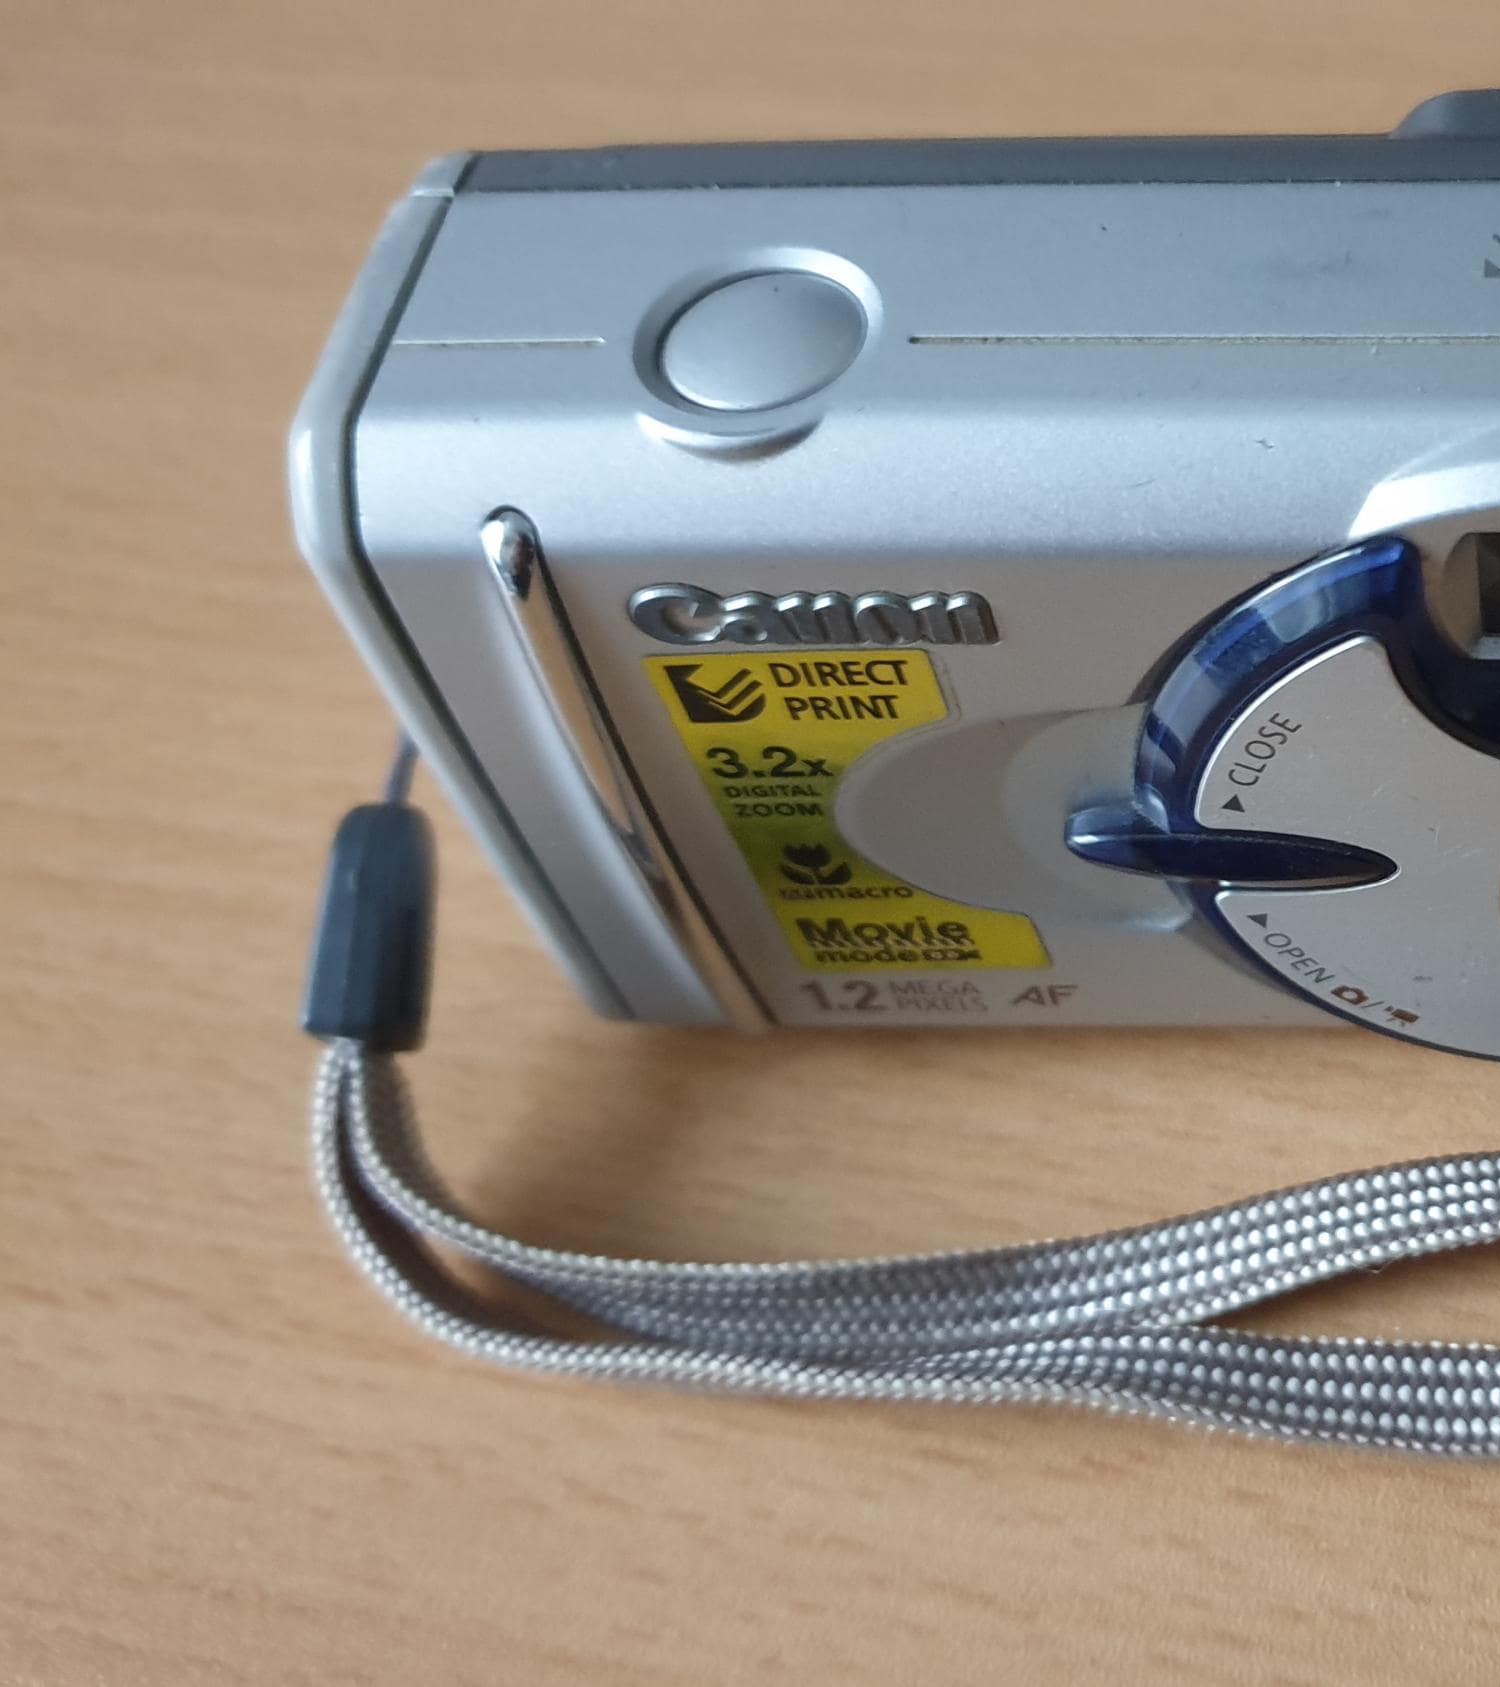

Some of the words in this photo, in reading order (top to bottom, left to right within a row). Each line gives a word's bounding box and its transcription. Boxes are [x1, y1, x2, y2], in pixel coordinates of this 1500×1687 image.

[626, 581, 1001, 646] Canon
[768, 659, 909, 687] DIRECT
[784, 694, 901, 721] PRINT
[706, 745, 835, 779] 3.2x
[1228, 712, 1303, 787] CLOSE
[723, 785, 823, 799] DIGITAL
[734, 802, 825, 818] ZOOM
[796, 916, 977, 948] Movie
[1264, 932, 1336, 984] OPEN
[801, 979, 886, 1011] 1.2
[887, 980, 980, 995] MEGA
[1010, 983, 1079, 1006] AF
